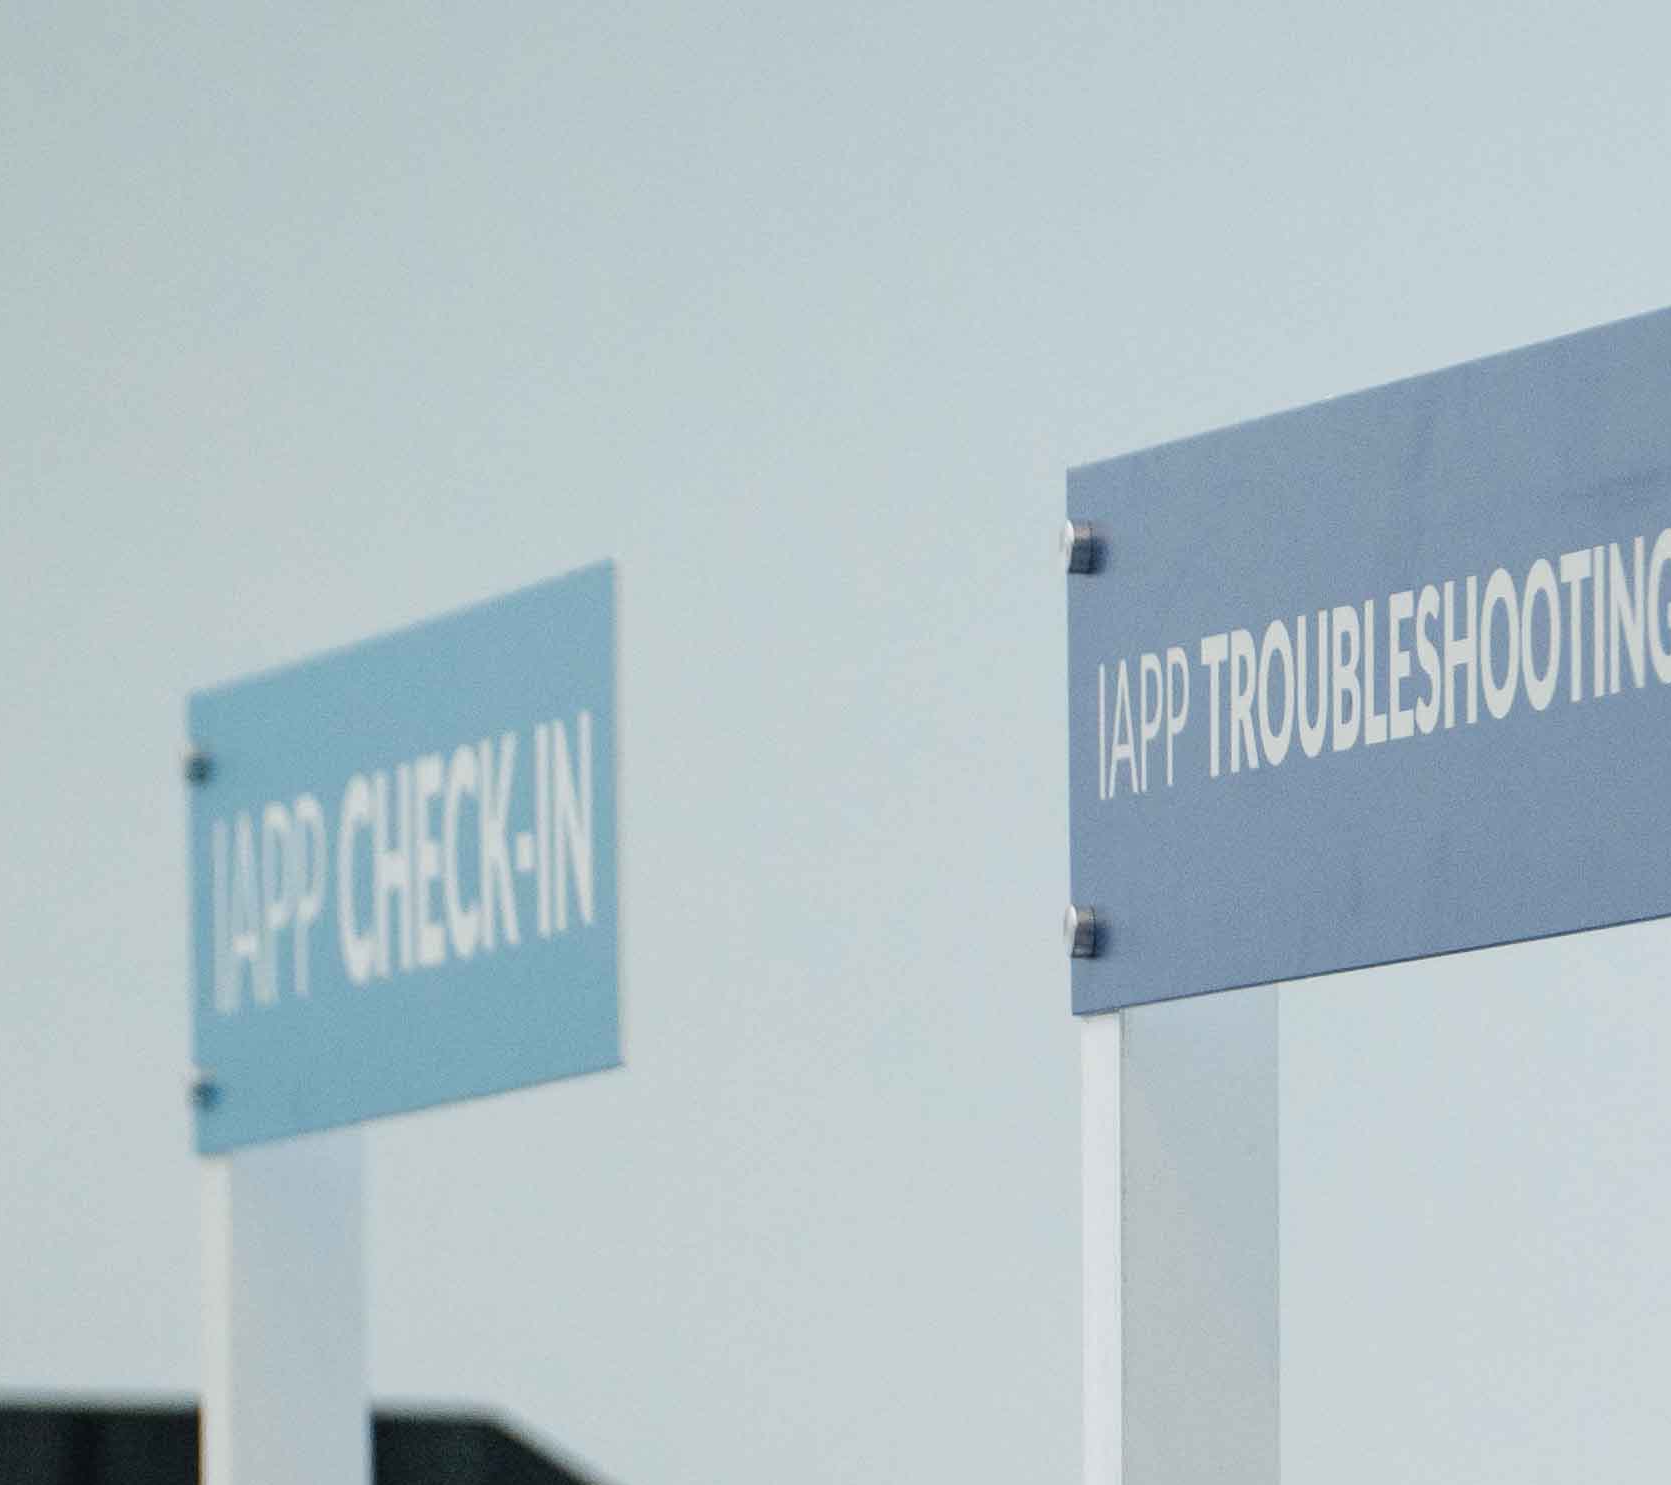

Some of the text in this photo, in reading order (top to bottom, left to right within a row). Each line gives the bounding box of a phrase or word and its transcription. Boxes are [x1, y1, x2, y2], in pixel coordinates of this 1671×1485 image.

[1098, 646, 1189, 800] IAPP
[212, 709, 594, 1014] IAPP CHECK-IN
